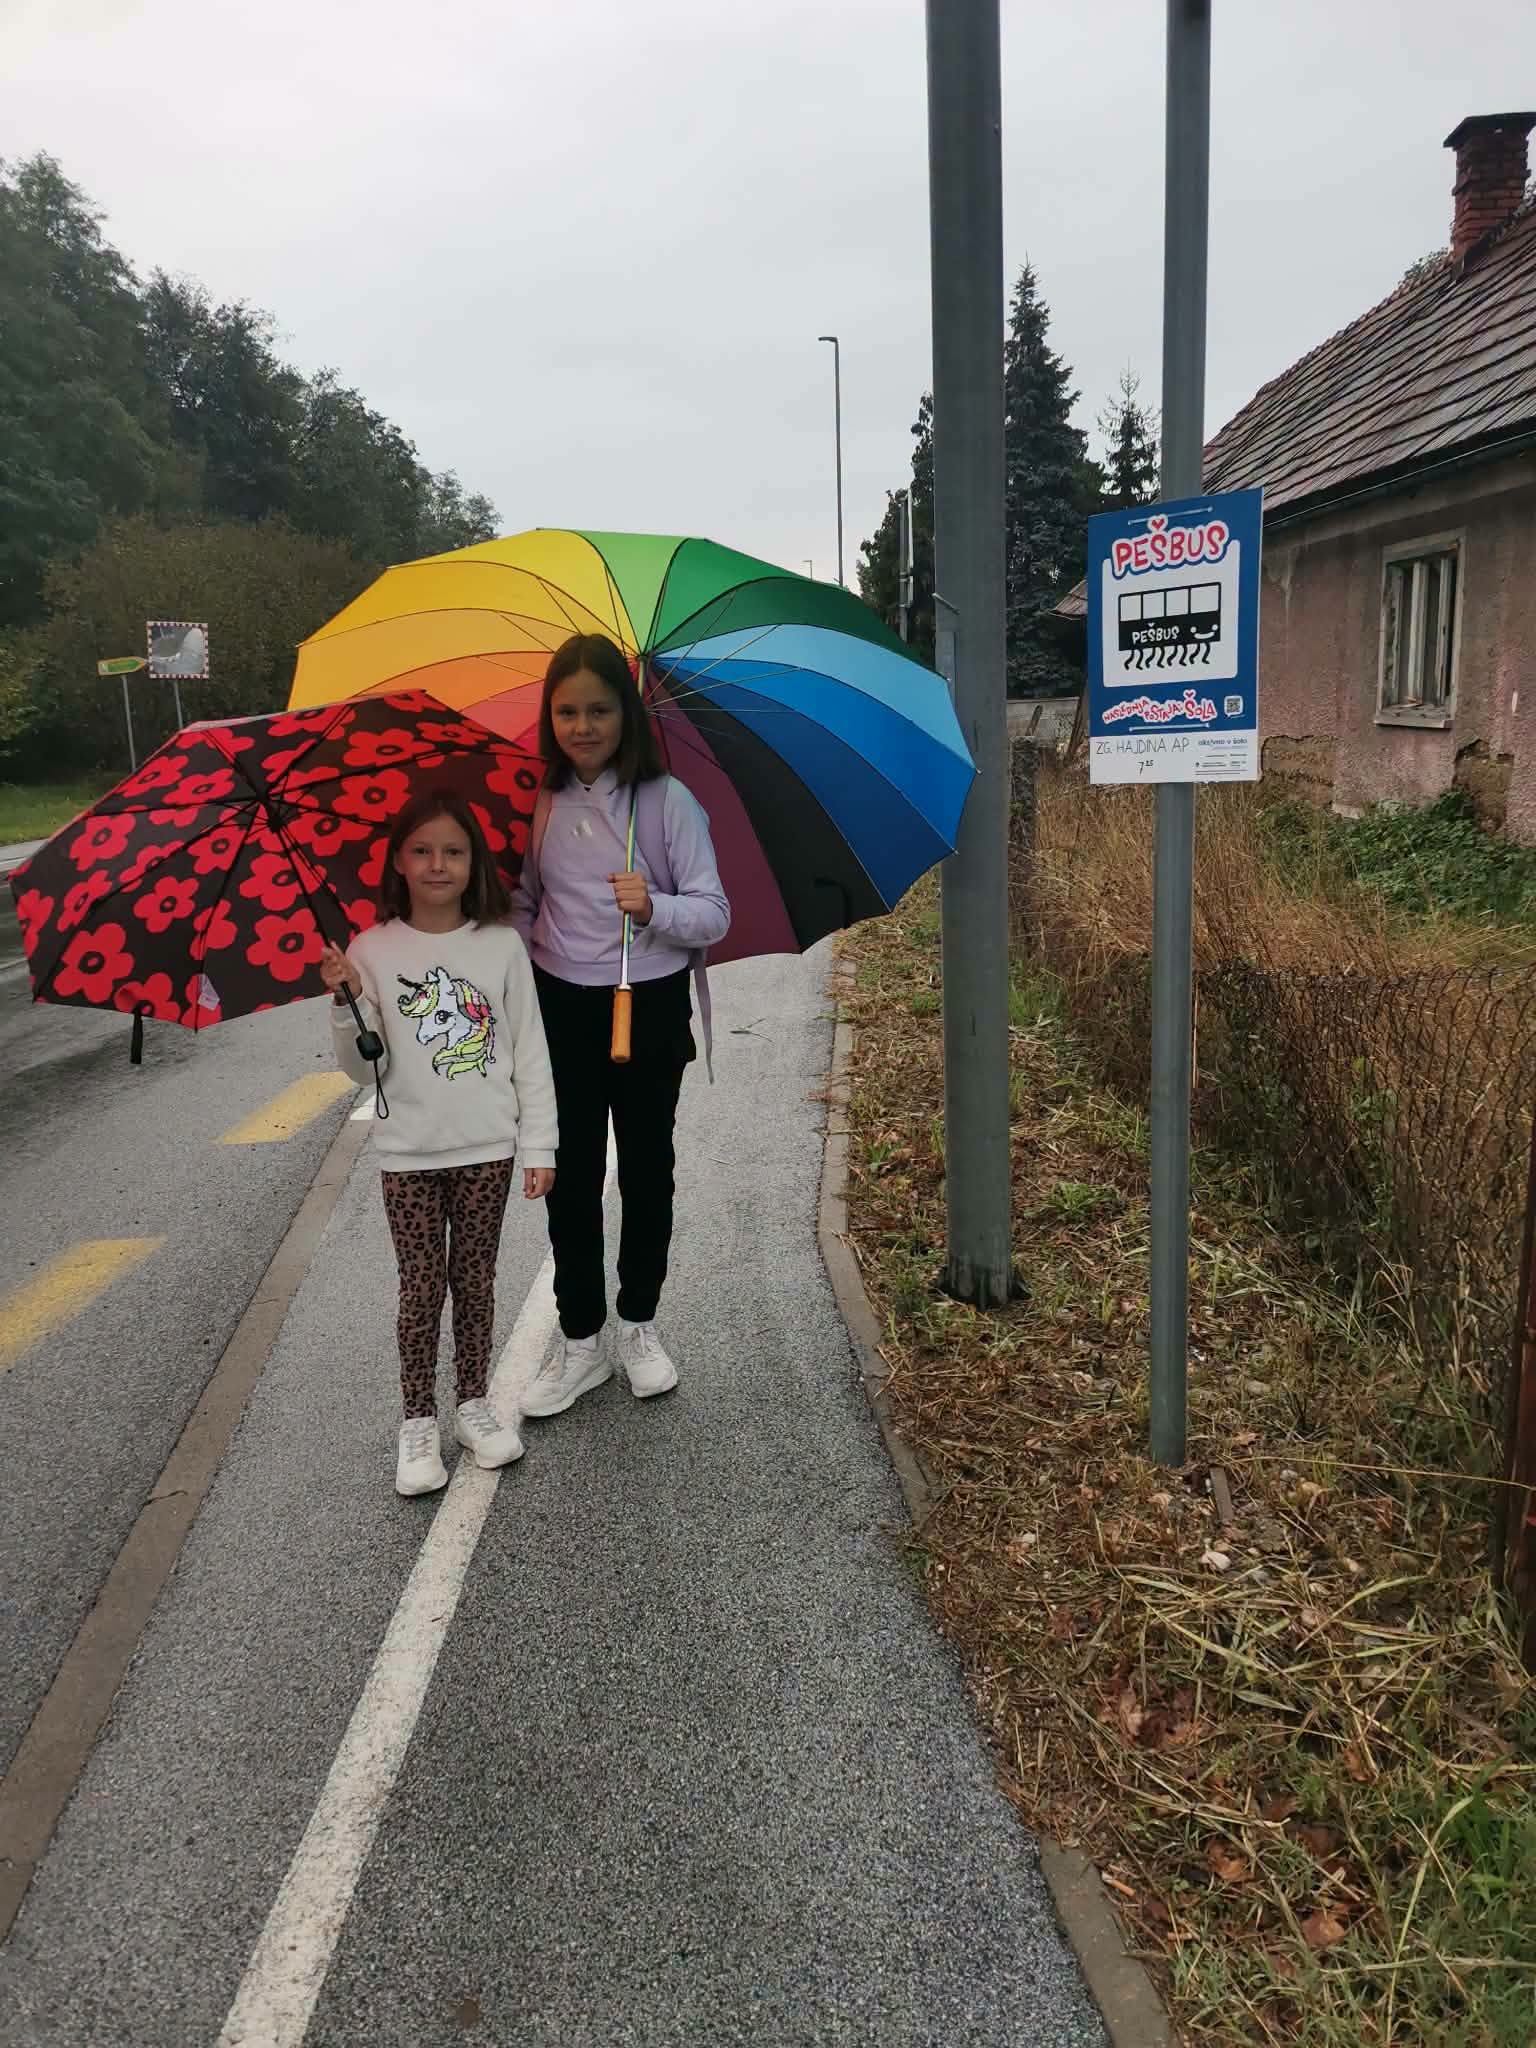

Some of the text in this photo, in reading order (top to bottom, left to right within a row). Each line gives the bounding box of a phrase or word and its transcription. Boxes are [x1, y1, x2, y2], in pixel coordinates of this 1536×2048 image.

[1113, 516, 1228, 574] PEŠBUS
[1132, 622, 1180, 645] PEŠBUS
[1184, 690, 1217, 720] ŠOLA
[1116, 737, 1167, 754] HAJDINA
[1172, 736, 1190, 753] AP
